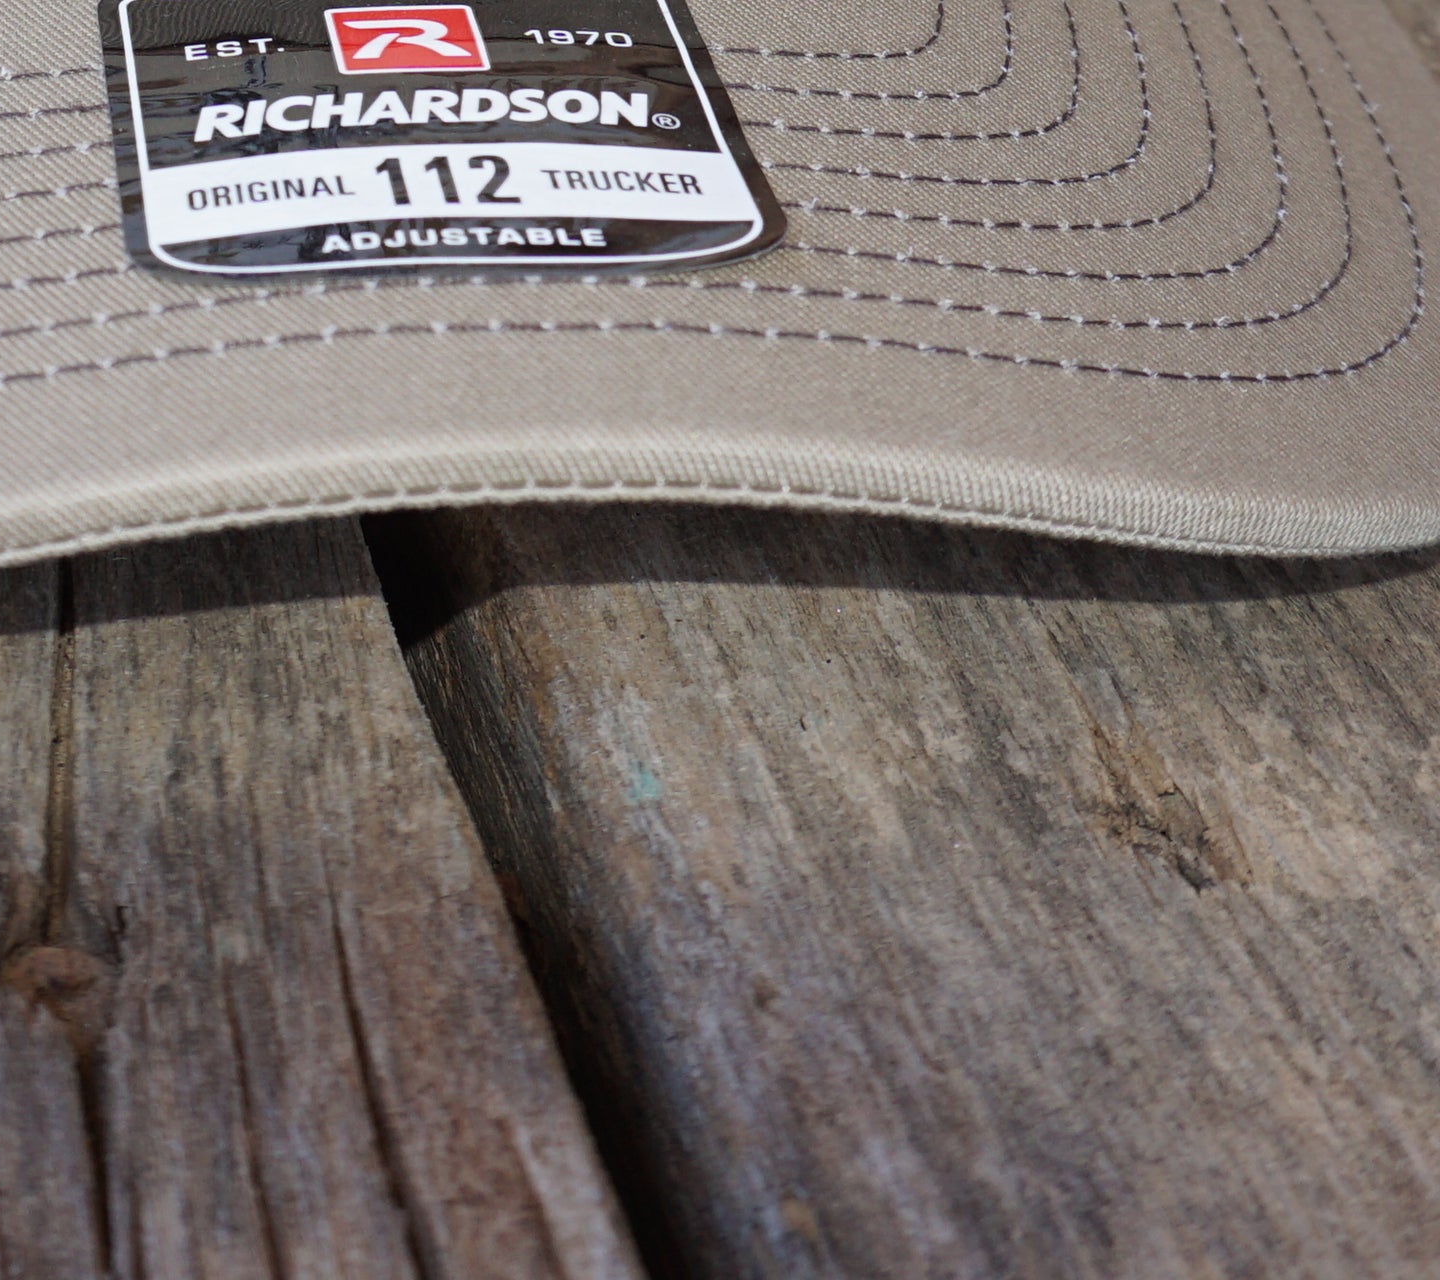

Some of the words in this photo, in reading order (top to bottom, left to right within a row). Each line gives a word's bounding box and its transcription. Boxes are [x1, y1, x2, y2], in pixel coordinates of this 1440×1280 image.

[183, 37, 286, 62] EST.
[524, 27, 634, 49] 1970
[186, 172, 357, 212] ORIGINAL
[374, 154, 523, 207] 112
[539, 168, 705, 196] TRUCKER
[320, 225, 608, 255] ADJUSTABLE
